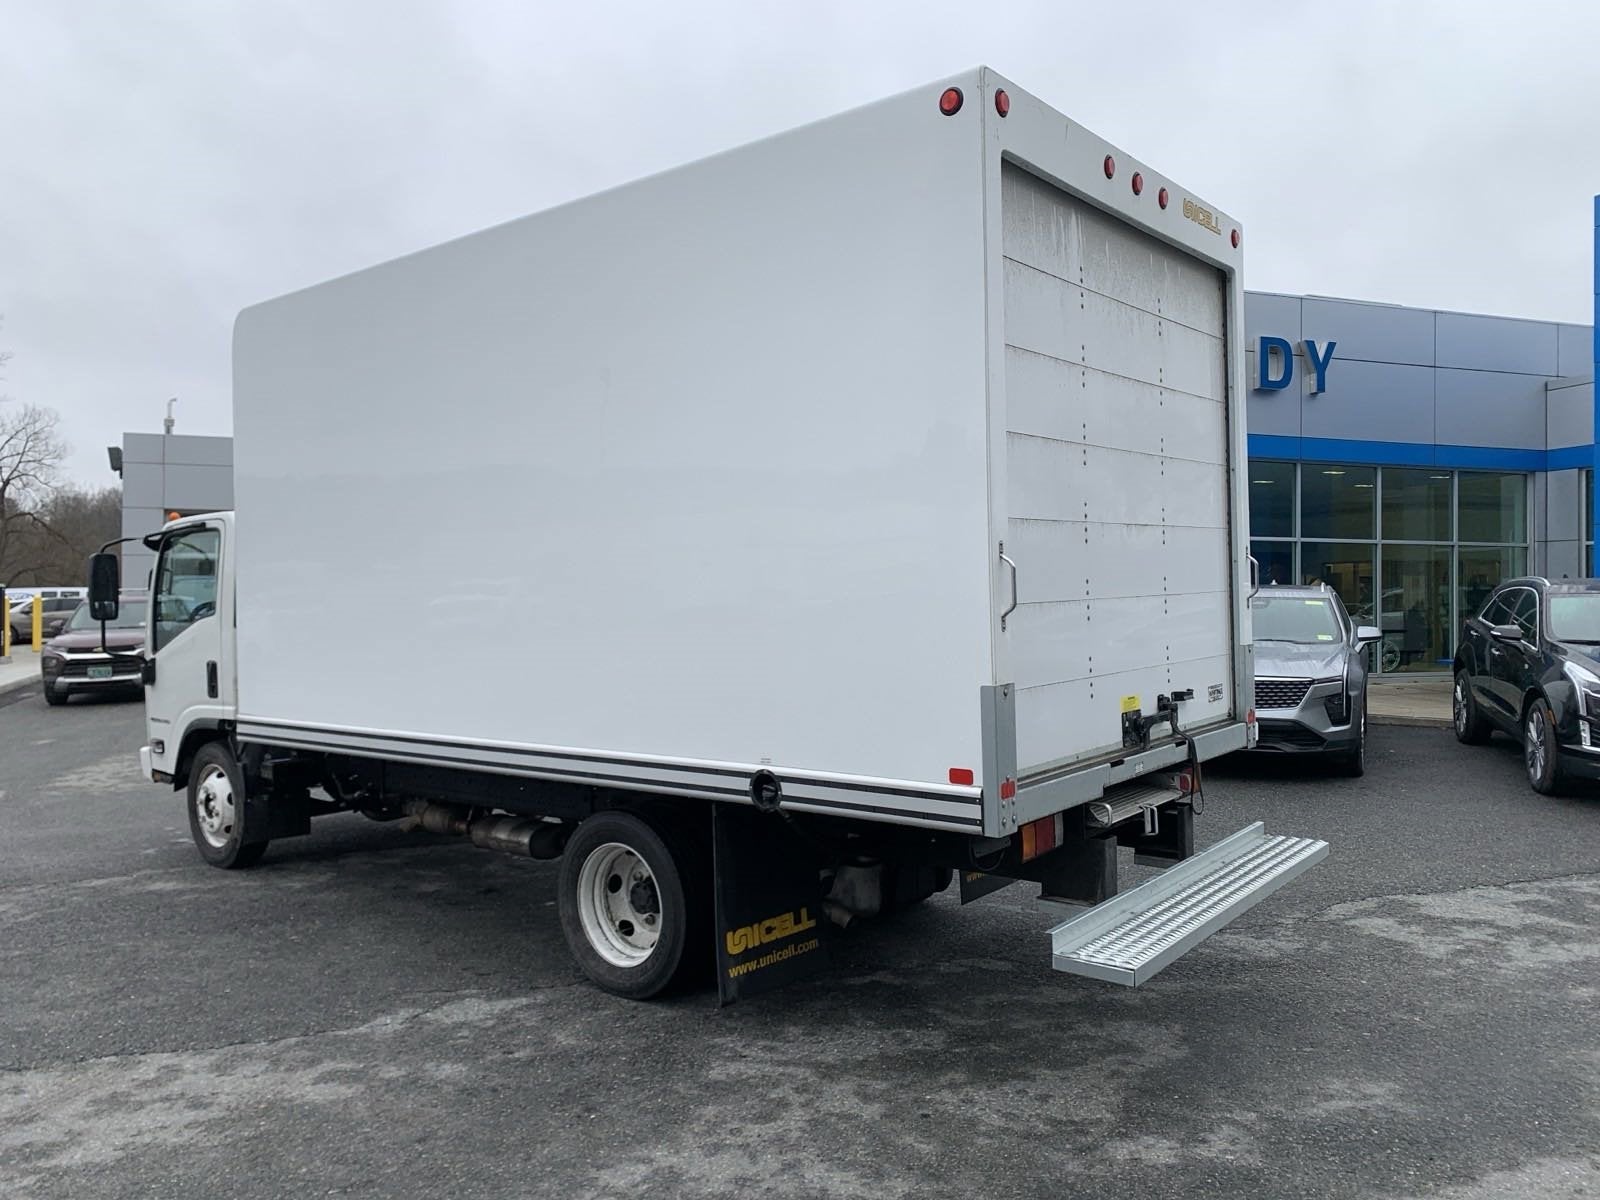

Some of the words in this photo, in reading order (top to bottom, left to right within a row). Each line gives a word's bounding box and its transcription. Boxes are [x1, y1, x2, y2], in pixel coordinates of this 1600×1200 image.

[1183, 198, 1221, 236] UNICELL
[726, 908, 817, 955] UNICELL
[728, 939, 819, 978] www.unicell.com
